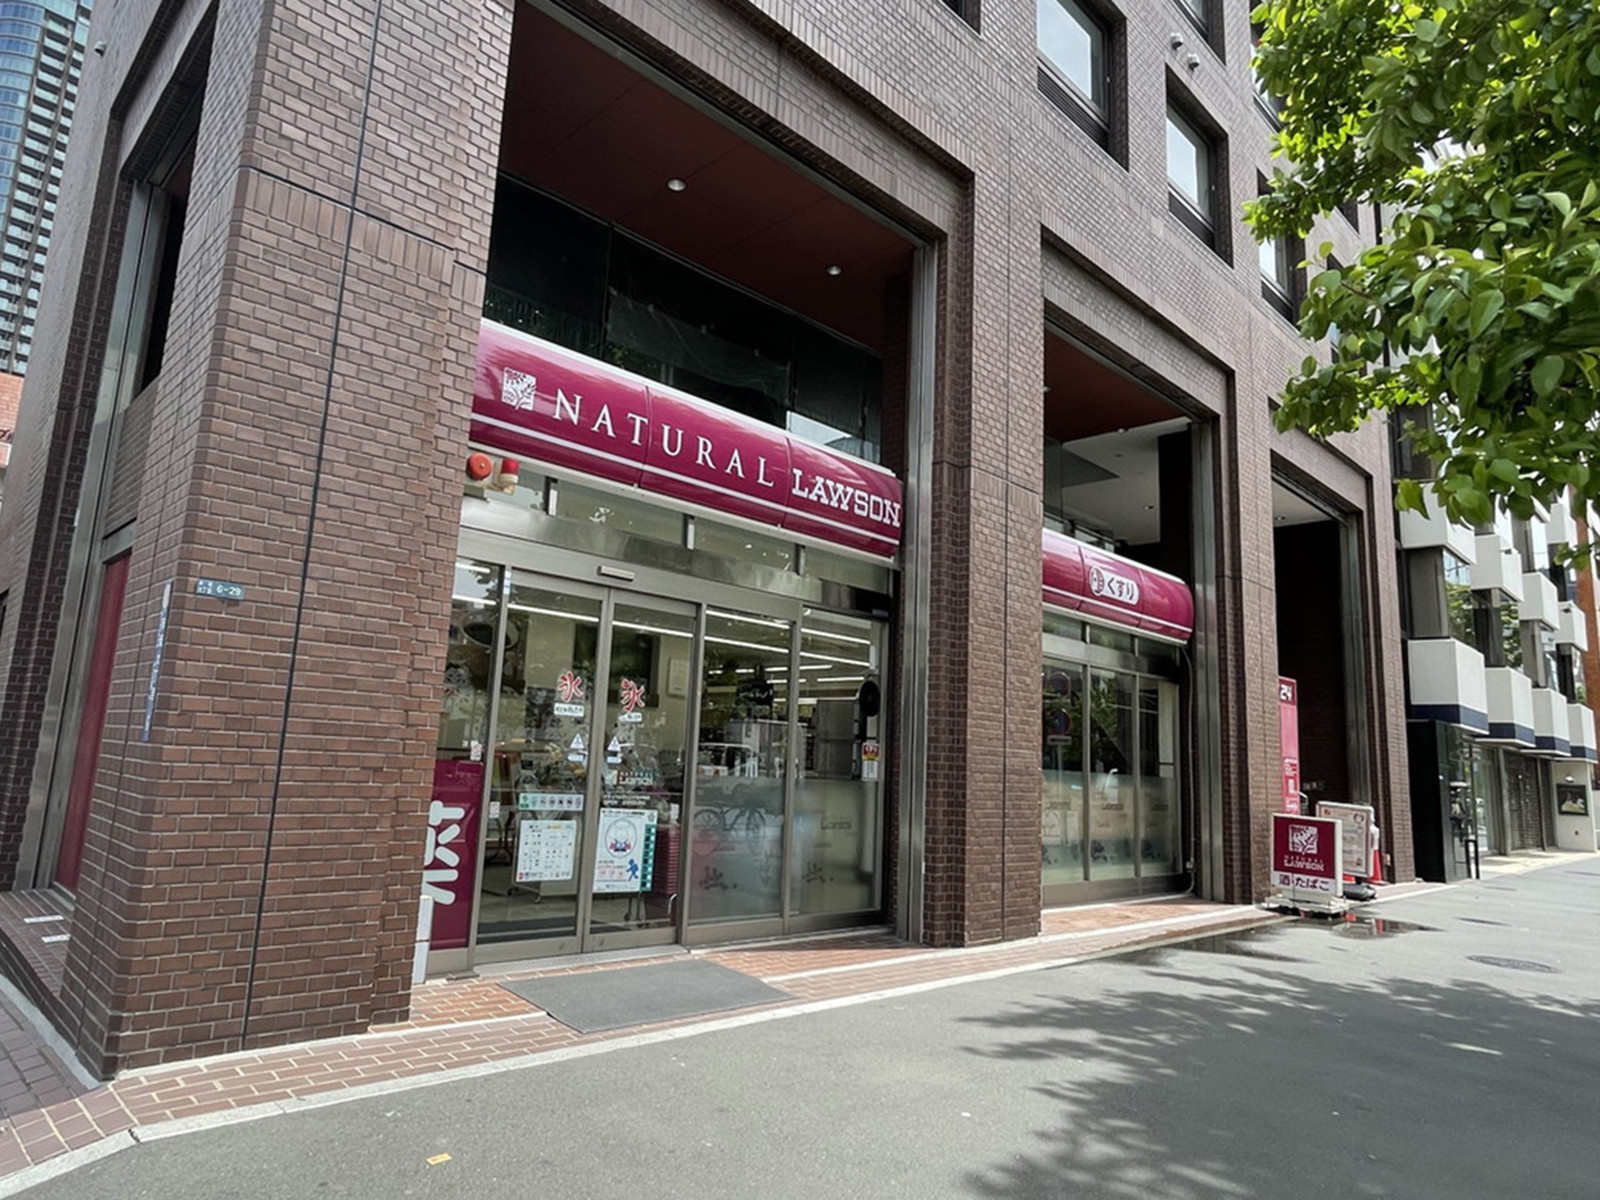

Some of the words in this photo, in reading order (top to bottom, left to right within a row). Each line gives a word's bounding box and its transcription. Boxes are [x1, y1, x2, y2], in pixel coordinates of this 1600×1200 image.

[552, 387, 774, 488] NATURAL
[791, 467, 901, 528] LAWSON
[1107, 577, 1135, 600] くすり
[557, 671, 584, 702] 氷
[620, 678, 645, 713] 氷
